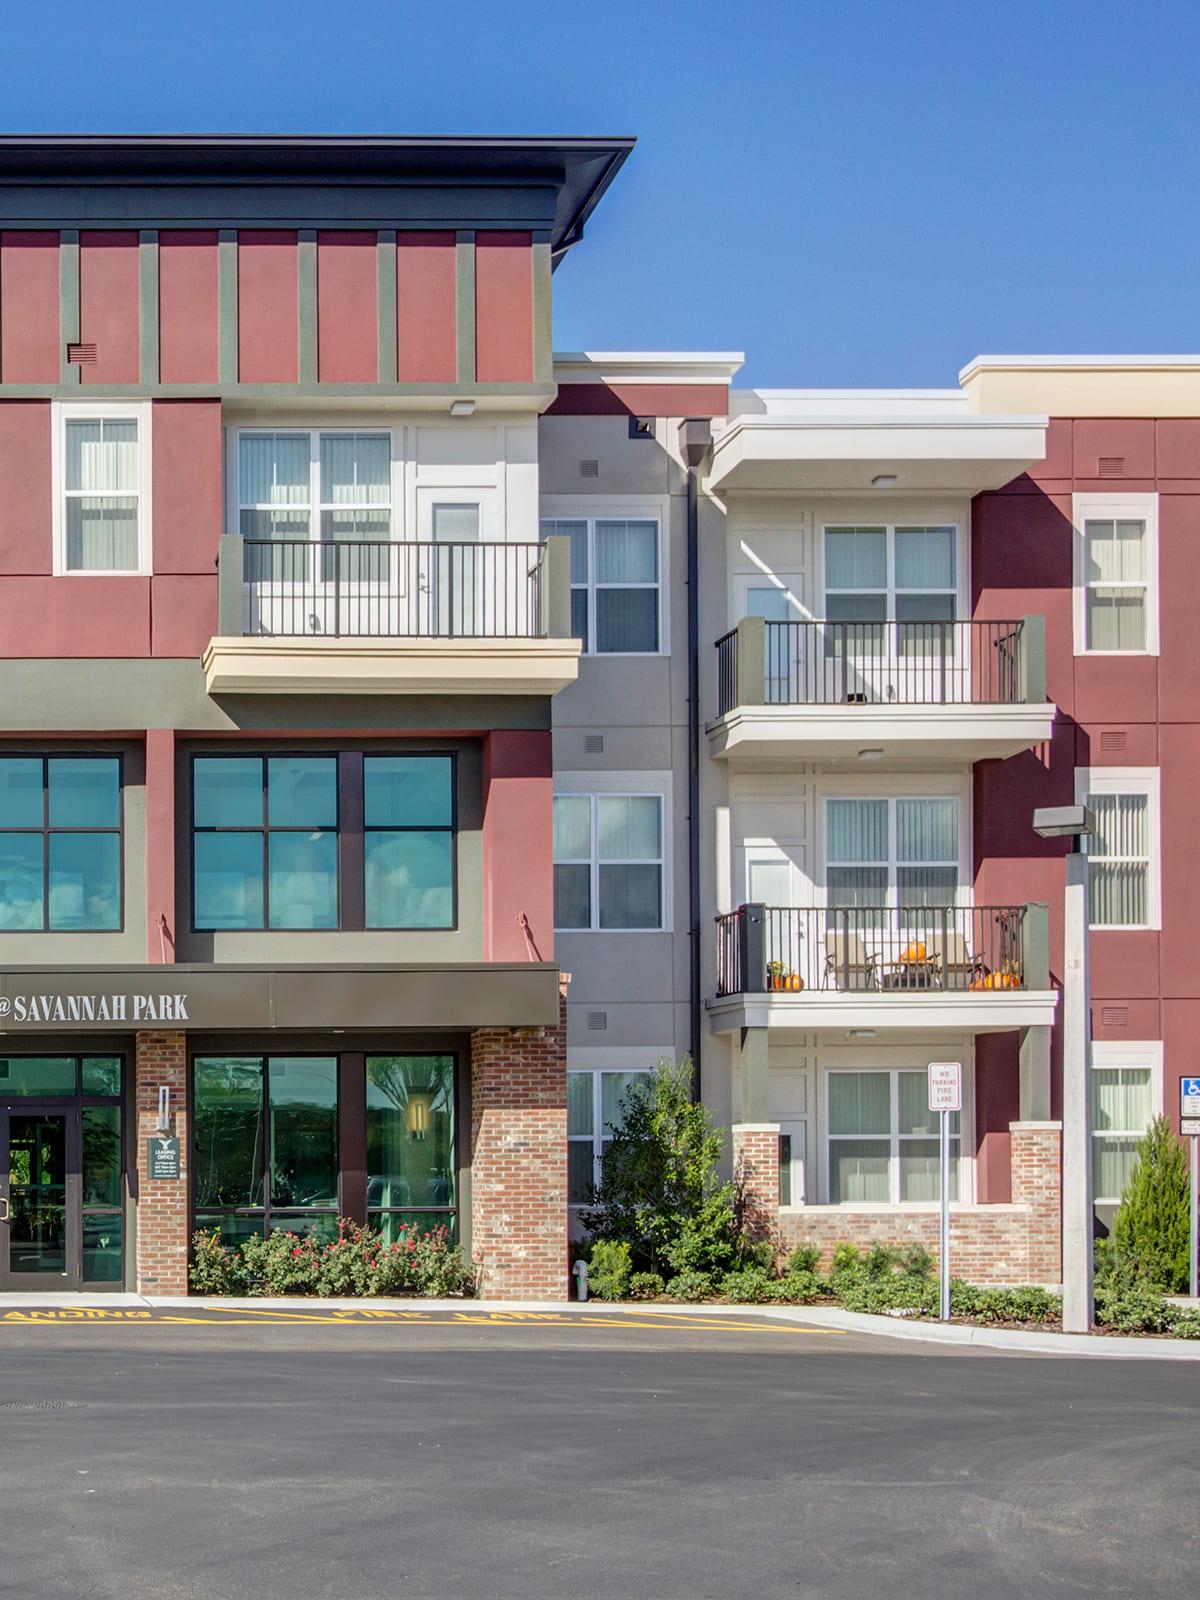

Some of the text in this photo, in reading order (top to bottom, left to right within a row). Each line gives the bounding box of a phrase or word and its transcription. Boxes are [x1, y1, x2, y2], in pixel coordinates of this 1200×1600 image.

[14, 994, 127, 1022] SAVANNAH
[132, 994, 190, 1021] PARK
[936, 1095, 952, 1103] LANE
